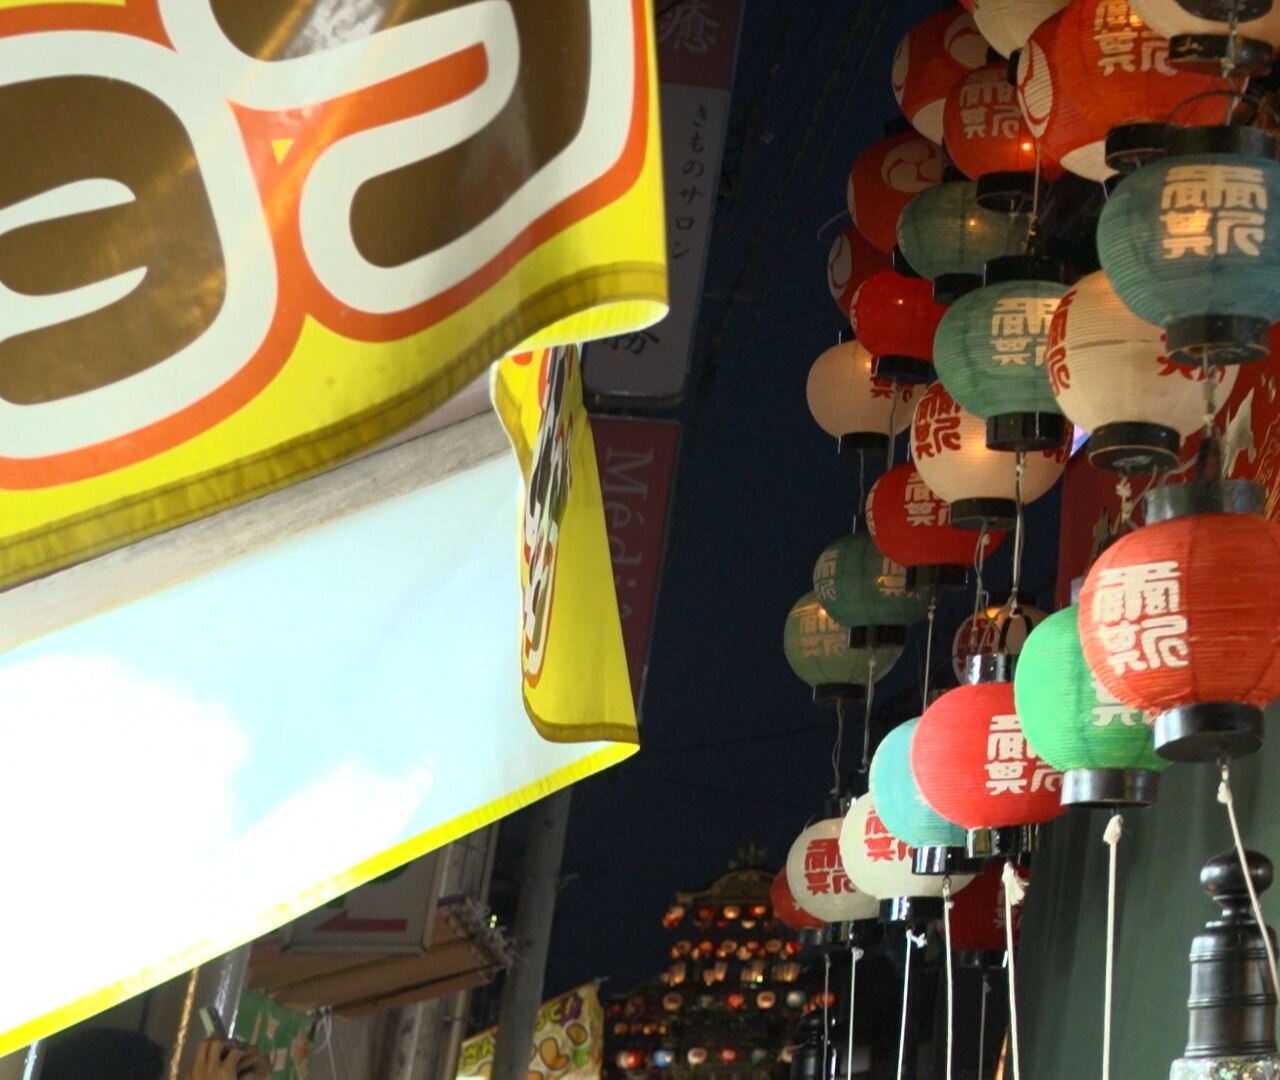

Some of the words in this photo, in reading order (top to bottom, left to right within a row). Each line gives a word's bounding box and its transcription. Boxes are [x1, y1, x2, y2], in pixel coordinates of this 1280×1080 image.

[670, 102, 708, 260] きものサロン
